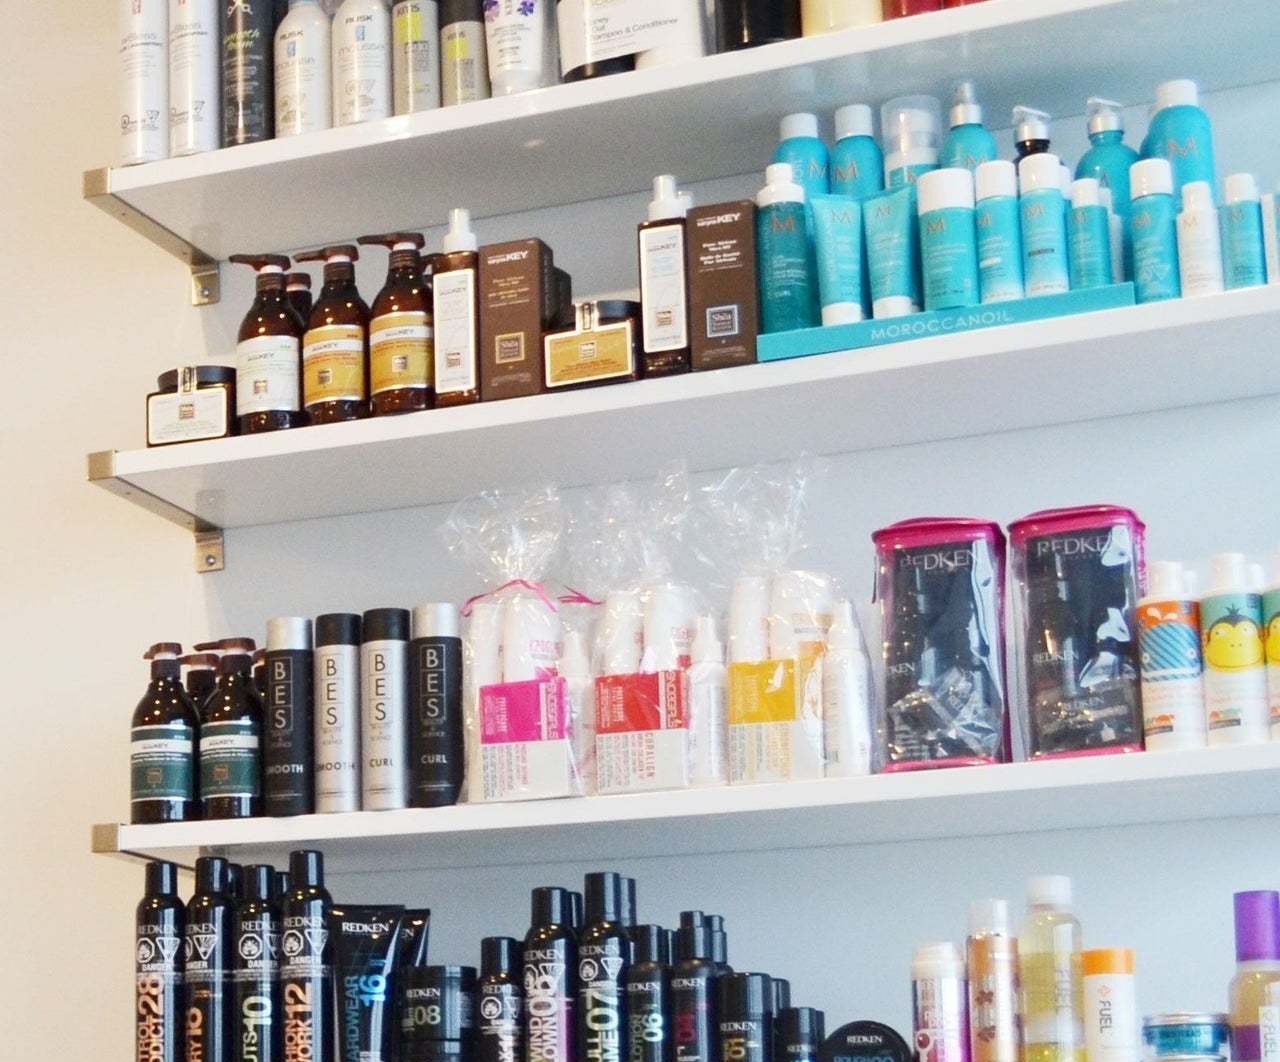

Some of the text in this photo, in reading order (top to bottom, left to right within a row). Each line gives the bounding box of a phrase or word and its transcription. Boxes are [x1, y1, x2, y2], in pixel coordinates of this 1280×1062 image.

[632, 17, 679, 32] Conditioner
[870, 310, 1014, 340] MOROCCANOIL
[1037, 534, 1111, 557] REDKE
[369, 757, 393, 768] CURL
[421, 754, 448, 764] CURL
[283, 915, 327, 928] REDKEN
[342, 921, 390, 934] REDKEN
[142, 962, 173, 972] DANGER
[138, 972, 164, 1016] 28
[285, 982, 313, 1018] 12
[359, 974, 387, 1007] 16
[406, 987, 441, 998] REDKEN
[414, 1004, 441, 1026] 08
[586, 989, 619, 1031] 07
[1099, 1000, 1112, 1033] FUEL
[630, 1014, 643, 1062] LOTION
[642, 1013, 663, 1042] 06
[720, 1021, 757, 1032] REDKEN
[530, 1017, 543, 1062] WIND
[847, 1034, 883, 1044] REDKEN
[1264, 1024, 1277, 1058] FUEL
